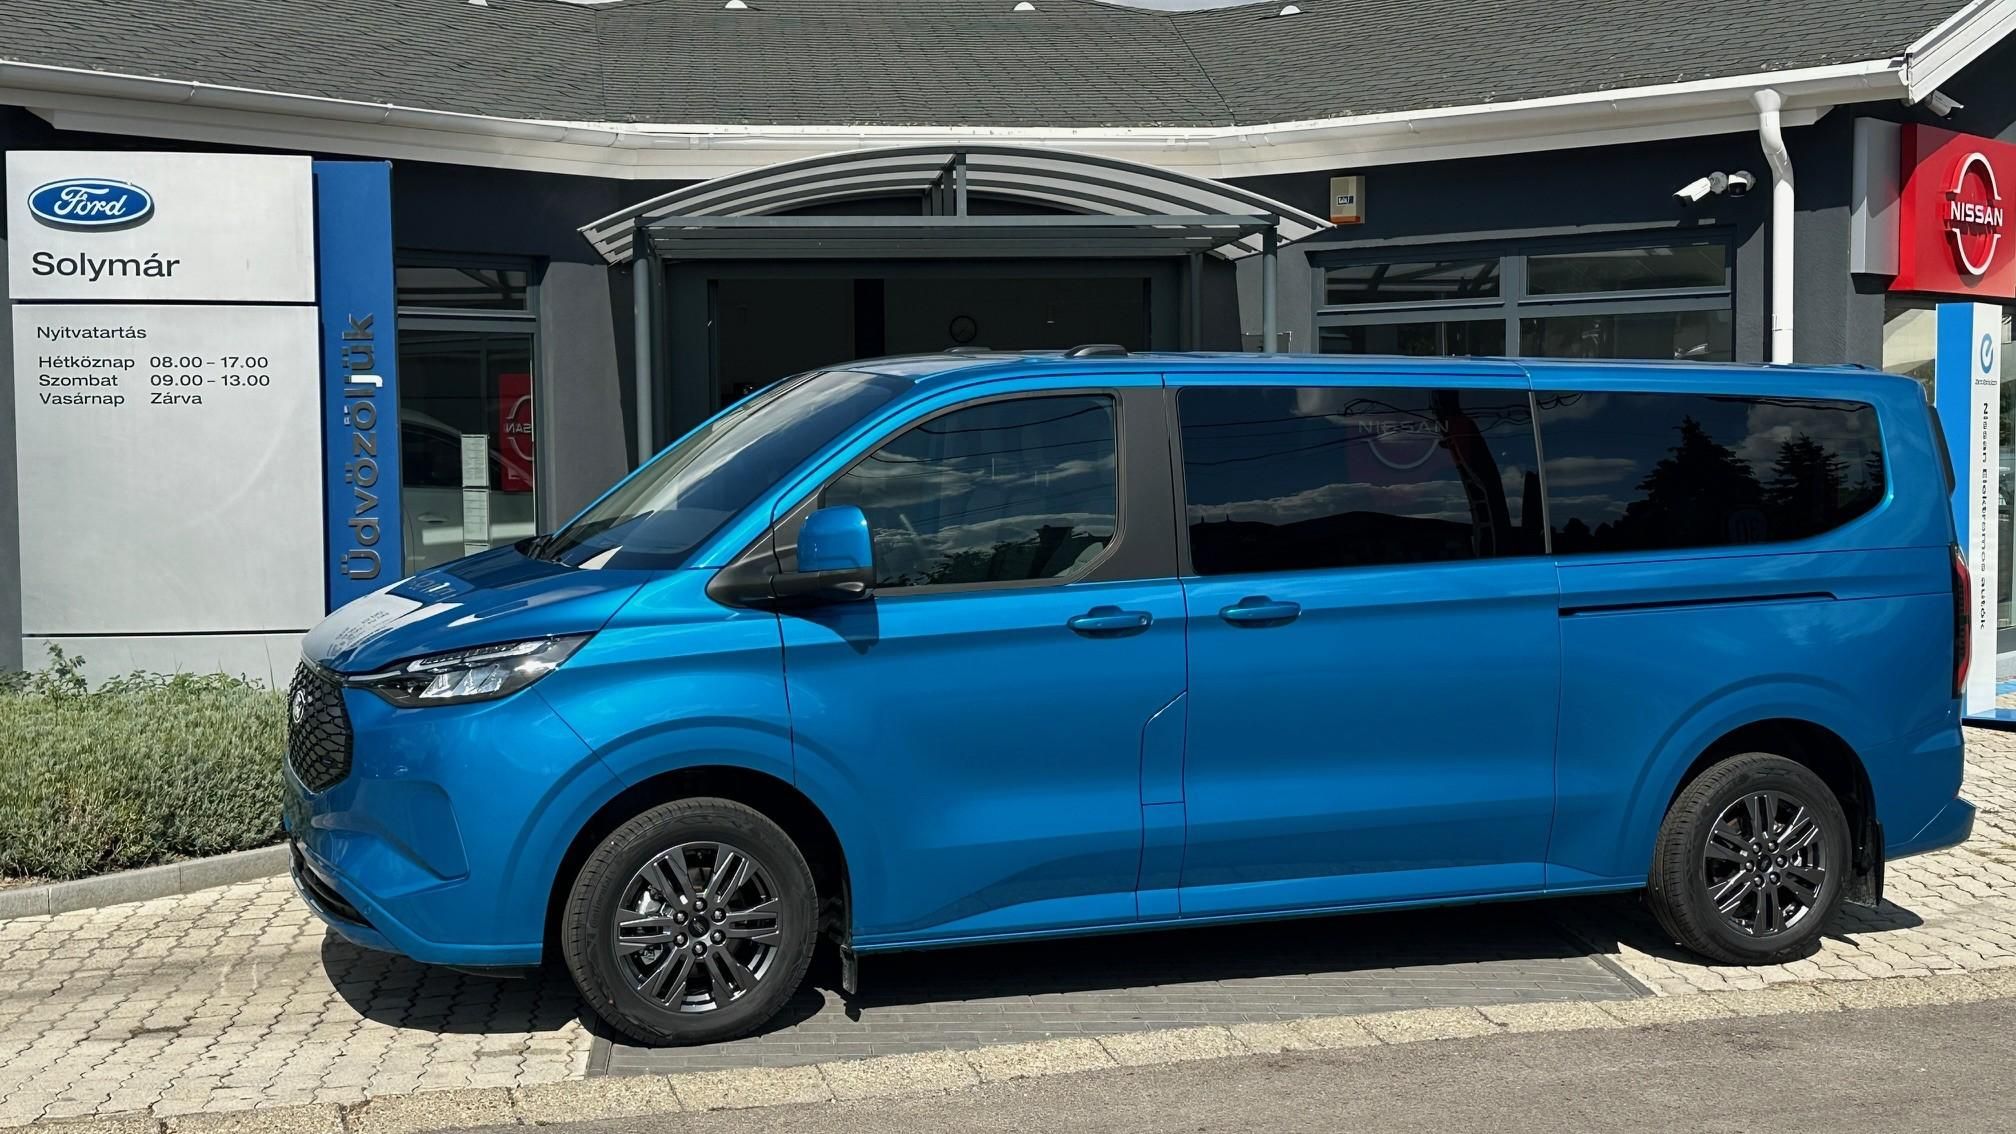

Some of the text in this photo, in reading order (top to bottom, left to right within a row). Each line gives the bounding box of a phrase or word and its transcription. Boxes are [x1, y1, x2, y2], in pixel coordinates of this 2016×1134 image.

[53, 186, 128, 216] Ford
[1951, 201, 2003, 227] NISSAN
[32, 252, 180, 282] Solymár
[37, 326, 147, 341] Nyitvatartás
[38, 355, 135, 370] Hétköznap
[150, 356, 203, 369] 08.00
[220, 356, 269, 369] 17.00
[38, 374, 118, 387] Szombat
[150, 374, 203, 387] 09.00
[222, 374, 270, 387] 13.00
[39, 391, 203, 407] Vasárnap Zárva
[340, 313, 383, 580] Üdvözöljük
